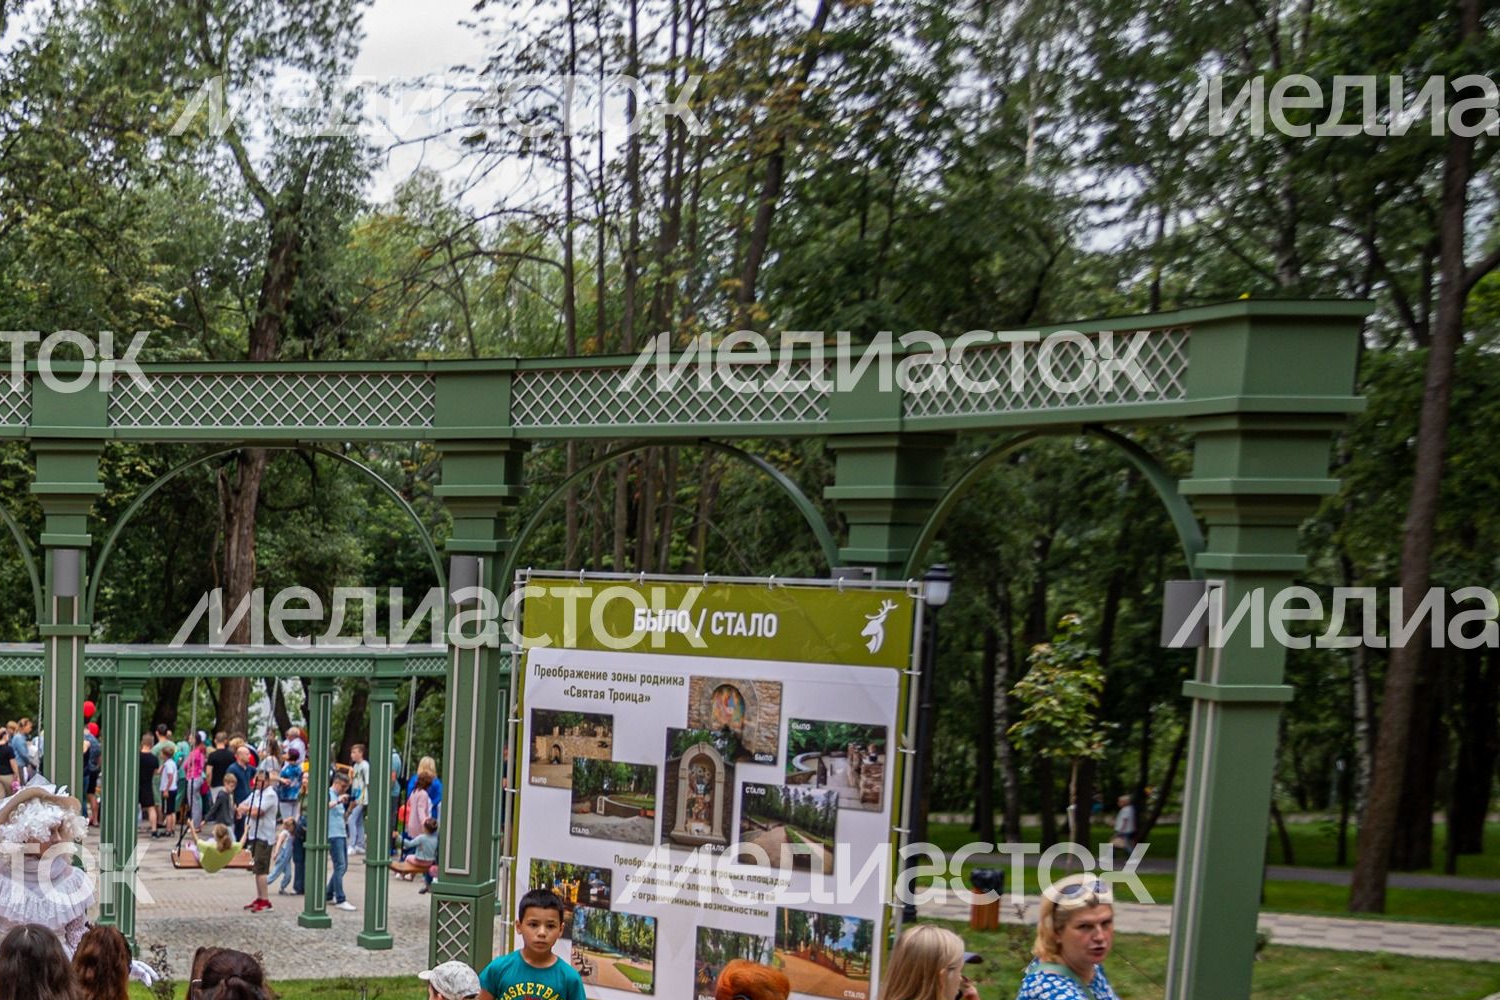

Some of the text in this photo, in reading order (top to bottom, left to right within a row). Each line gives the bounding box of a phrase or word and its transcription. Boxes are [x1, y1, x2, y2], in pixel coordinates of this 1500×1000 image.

[634, 607, 691, 634] БЫЛО
[711, 611, 778, 638] СТАЛО
[534, 664, 685, 686] Преображение зоны родника
[563, 685, 651, 704] «Святая Троица»
[703, 901, 769, 917] возможностями
